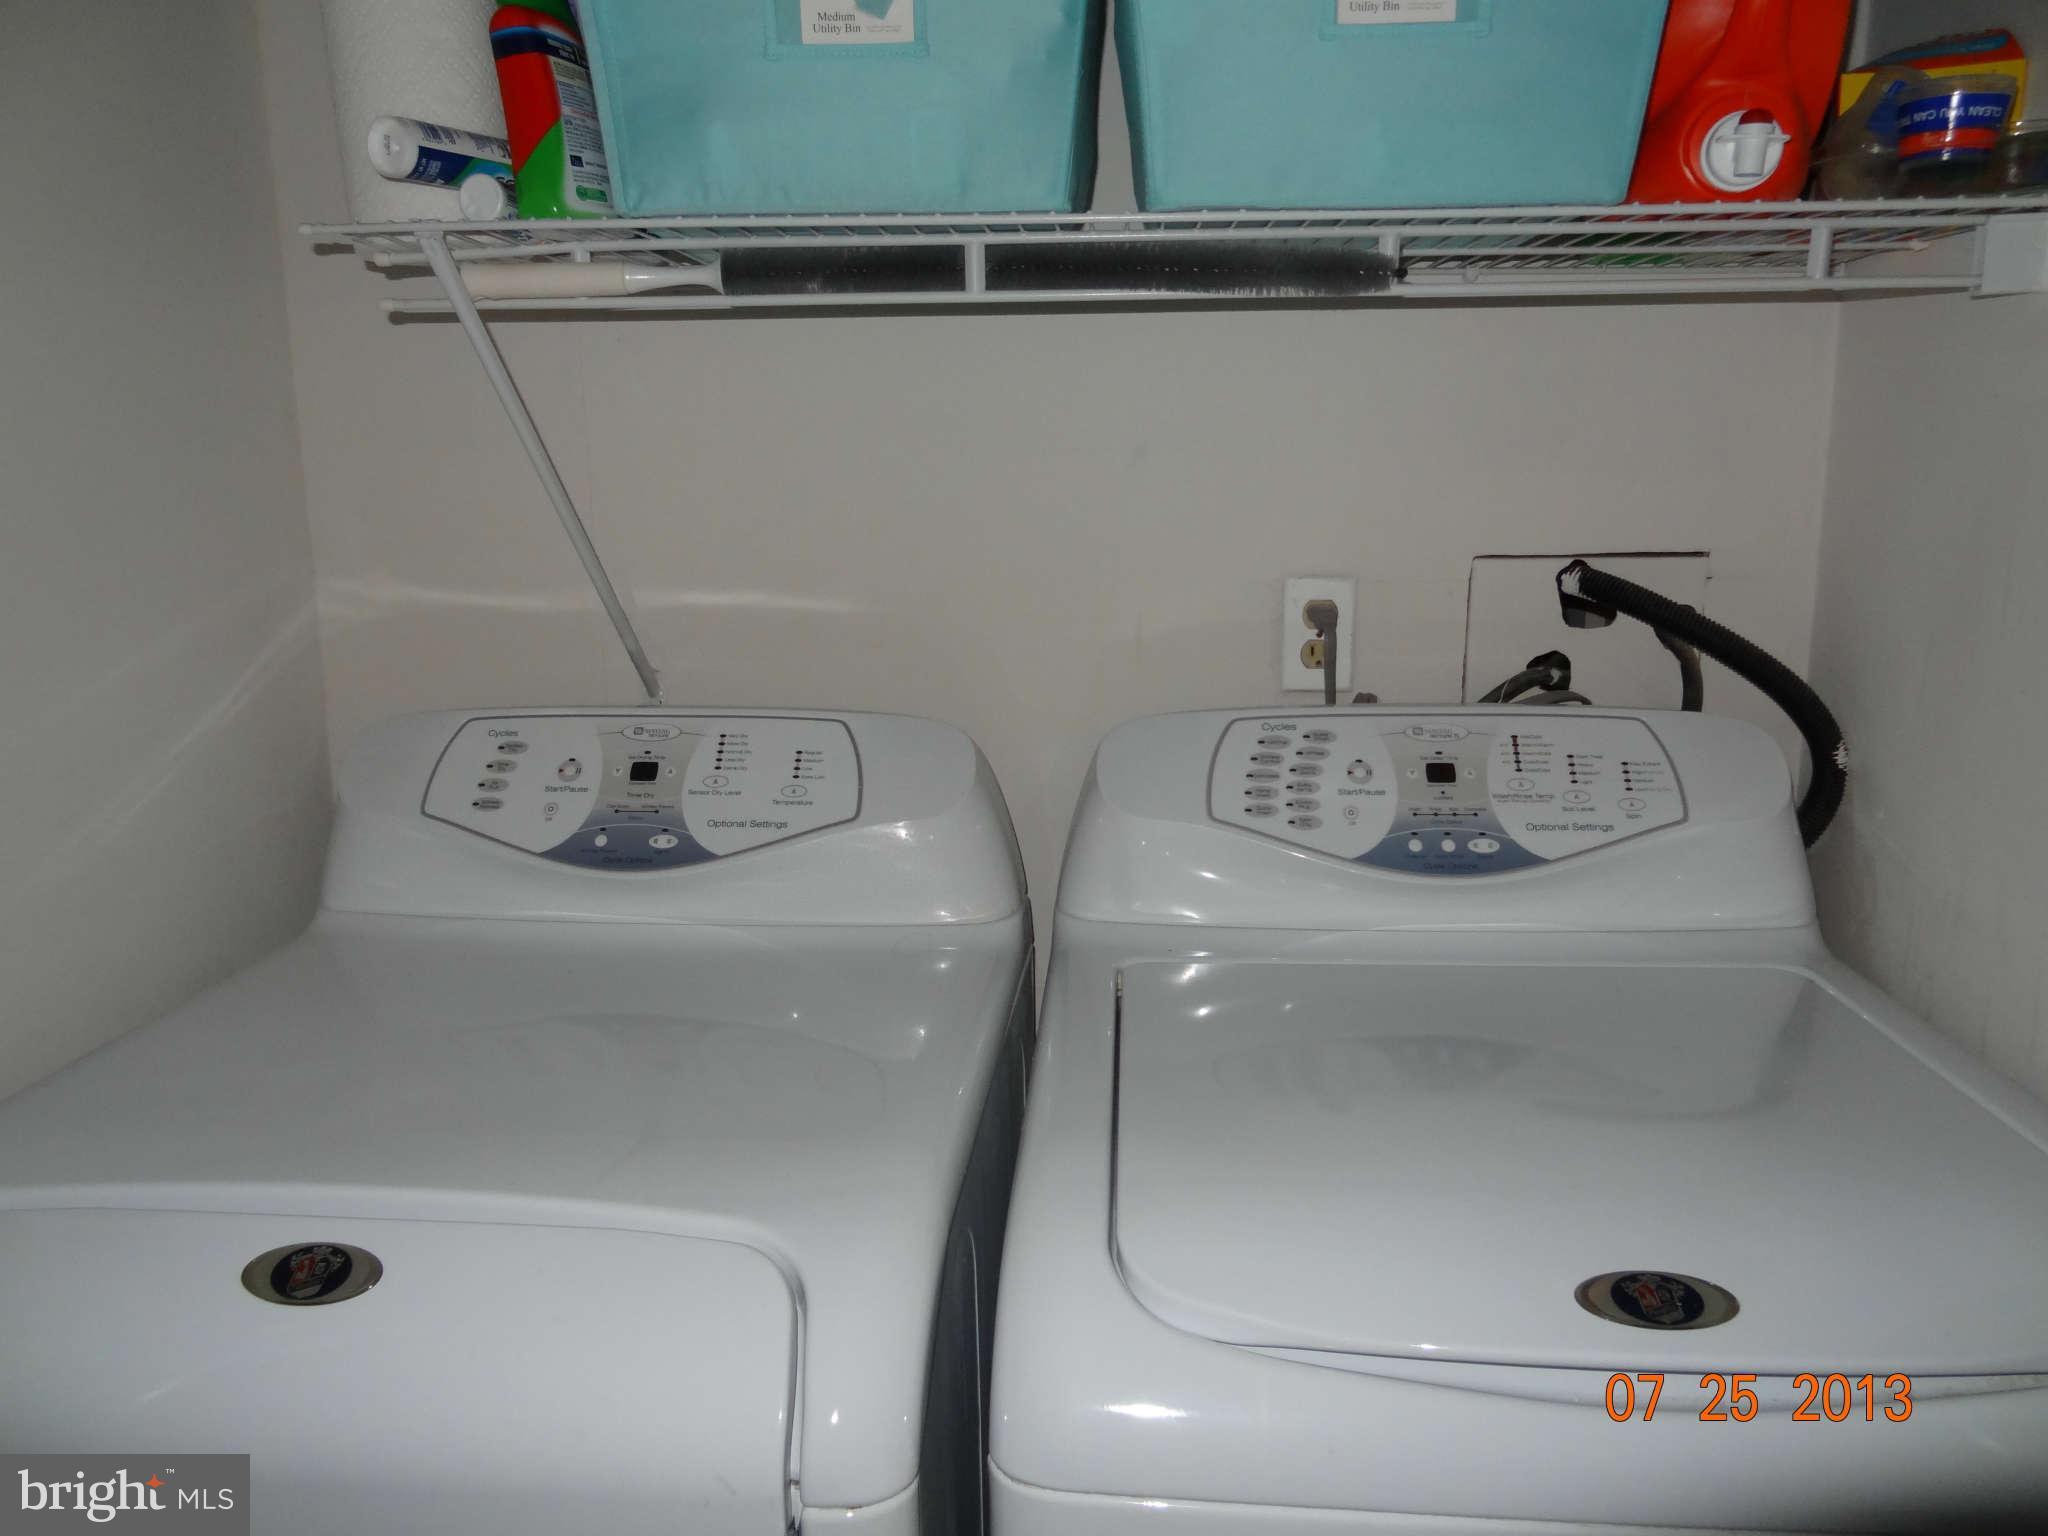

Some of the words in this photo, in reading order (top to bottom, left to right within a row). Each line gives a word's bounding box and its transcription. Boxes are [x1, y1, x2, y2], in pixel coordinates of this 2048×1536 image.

[1349, 0, 1379, 14] Utility
[1383, 0, 1400, 12] Bin
[817, 12, 856, 21] Medium
[813, 23, 841, 36] Utility
[844, 24, 862, 33] Bin
[1912, 110, 1937, 123] CAN
[1966, 105, 2002, 118] CLEAN
[1262, 722, 1297, 733] Cycles
[487, 729, 520, 738] Cycles
[712, 789, 723, 798] Dry
[1337, 788, 1386, 796] Start/Pause
[707, 818, 747, 830] Optional
[749, 818, 788, 830] Settings
[1525, 822, 1570, 833] Optional
[1572, 822, 1615, 833] Settings
